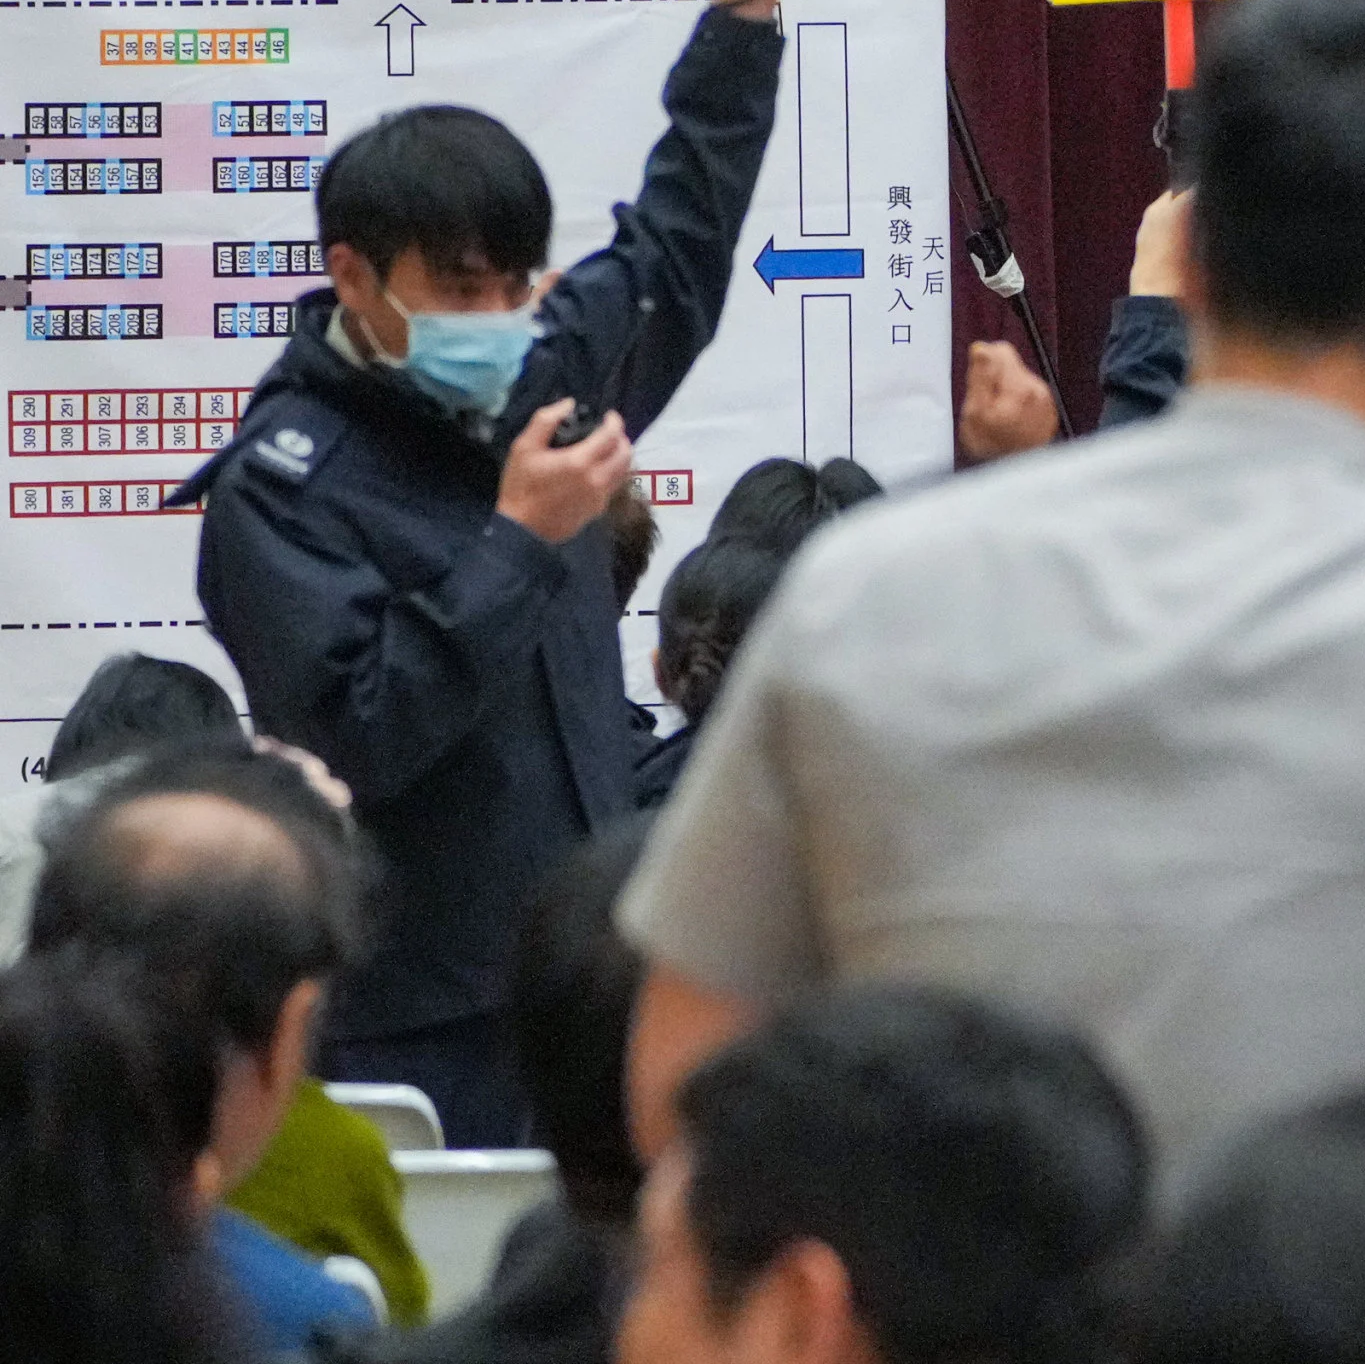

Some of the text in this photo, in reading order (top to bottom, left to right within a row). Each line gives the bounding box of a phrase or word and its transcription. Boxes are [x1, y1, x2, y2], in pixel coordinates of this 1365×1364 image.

[108, 40, 286, 56] 37 38 39 40 41 42 43 44 45 46
[32, 115, 157, 130] 59 58 57 56 55 54 53
[220, 113, 323, 128] 52 51 50 49 48 47
[32, 167, 157, 188] 152 153 154 155 156 157 158
[220, 166, 232, 186] 159
[238, 166, 250, 186] 160
[257, 166, 269, 186] 161
[275, 165, 287, 185] 162
[293, 165, 305, 185] 163
[33, 251, 158, 272] 177 176 175 174 173 172 171
[221, 249, 324, 270] 170 169 168 167 166 165
[886, 184, 914, 345] 興發街入口
[921, 237, 945, 297] 天后
[33, 313, 158, 335] 204 205 206 207 208 209 210
[221, 311, 288, 333] 211 212 213 214
[24, 395, 223, 418] 290 291 292 293 294 295
[24, 425, 223, 449] 309 308 307 306 305 304
[666, 476, 679, 498] 396
[25, 487, 149, 510] 380 381 382 383
